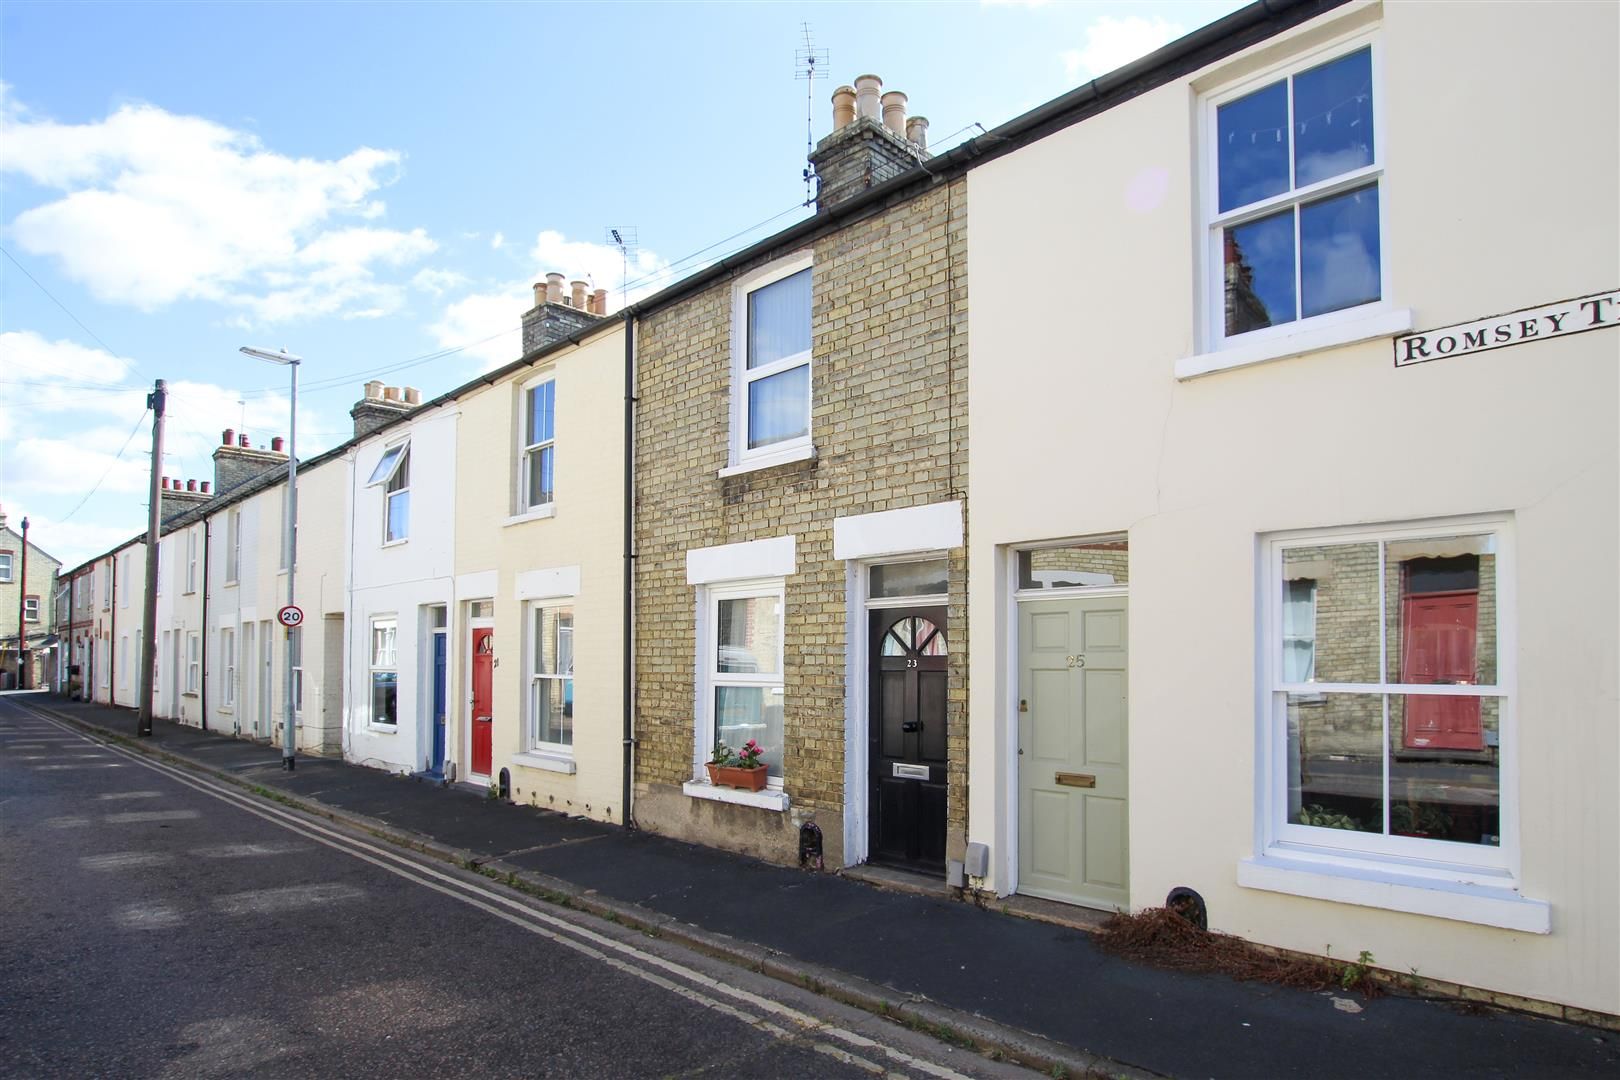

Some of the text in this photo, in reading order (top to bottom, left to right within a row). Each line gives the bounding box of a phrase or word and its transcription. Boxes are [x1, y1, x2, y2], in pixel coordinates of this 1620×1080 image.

[1402, 297, 1620, 362] ROMSEY T
[283, 612, 300, 621] 20
[907, 659, 918, 668] 23
[1065, 654, 1085, 668] 25
